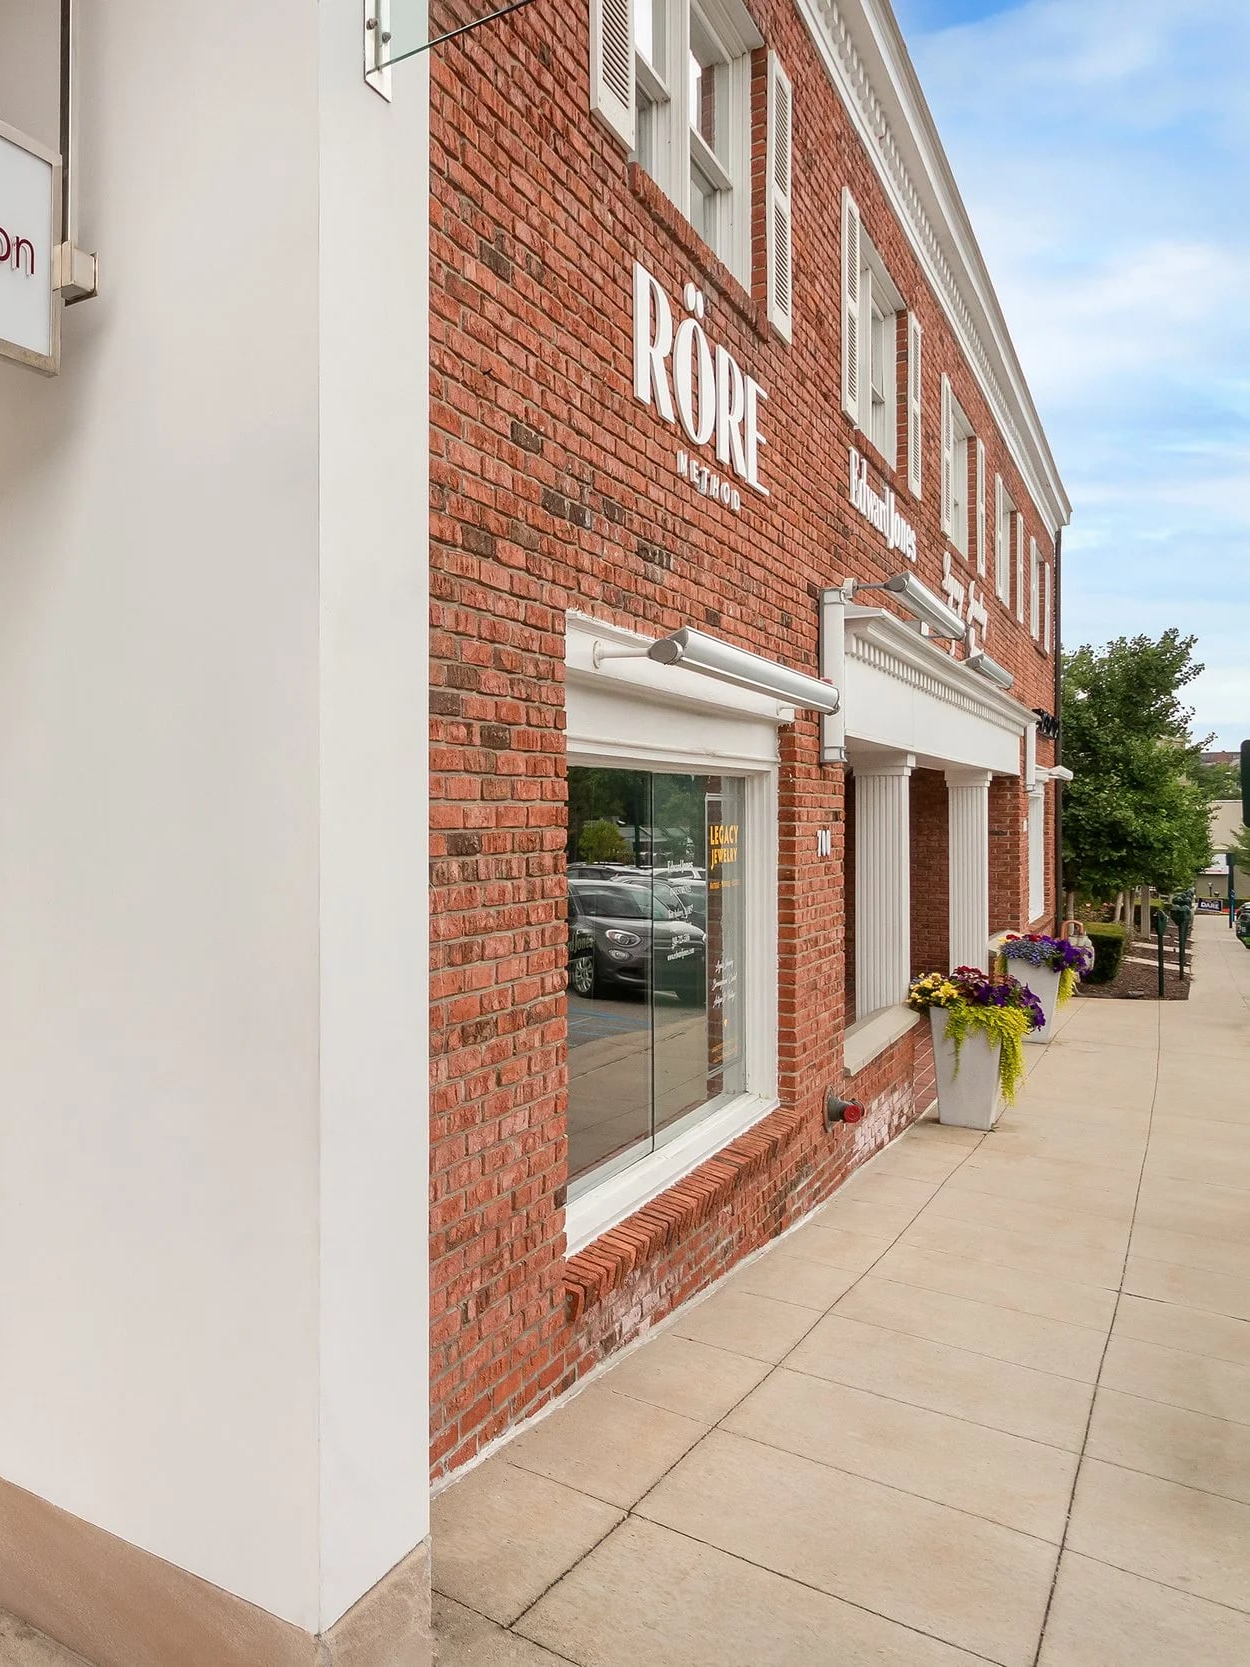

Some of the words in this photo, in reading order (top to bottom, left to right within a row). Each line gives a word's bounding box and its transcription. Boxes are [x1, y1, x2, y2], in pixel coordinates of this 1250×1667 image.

[676, 449, 741, 512] METHOD
[710, 825, 739, 846] LEGACY
[711, 847, 738, 870] JEWELRY
